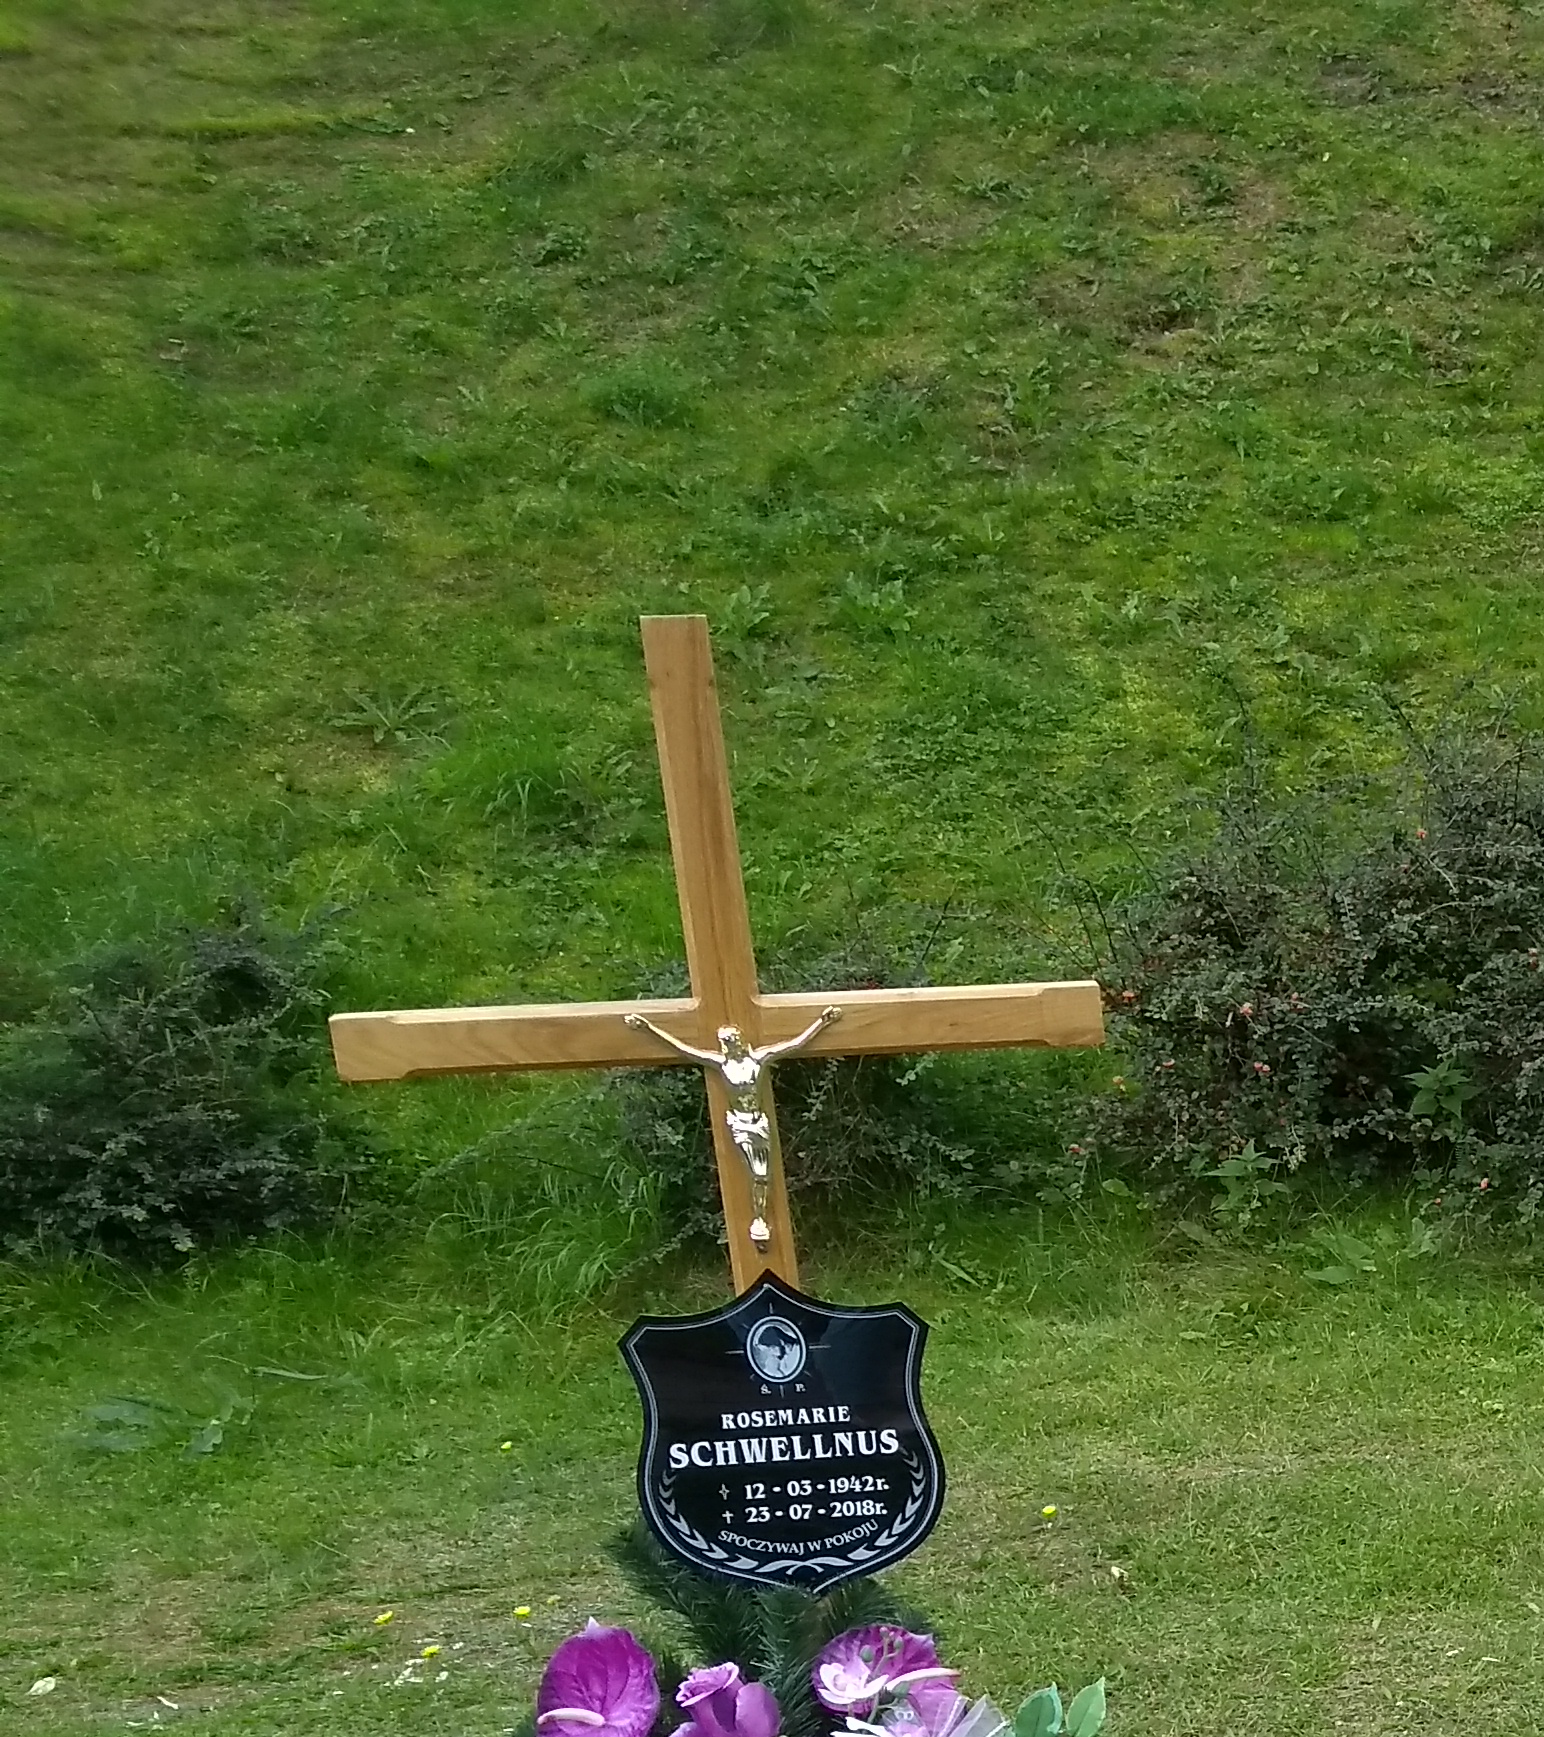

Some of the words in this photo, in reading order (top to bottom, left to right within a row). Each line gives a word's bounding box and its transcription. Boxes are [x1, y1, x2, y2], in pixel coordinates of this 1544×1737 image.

[721, 1405, 851, 1430] ROSEMARIE
[669, 1428, 900, 1469] SCHWELLNUS
[718, 1529, 804, 1556] SPOCZYWAJ
[807, 1540, 822, 1552] W
[824, 1518, 879, 1549] POKOJU
